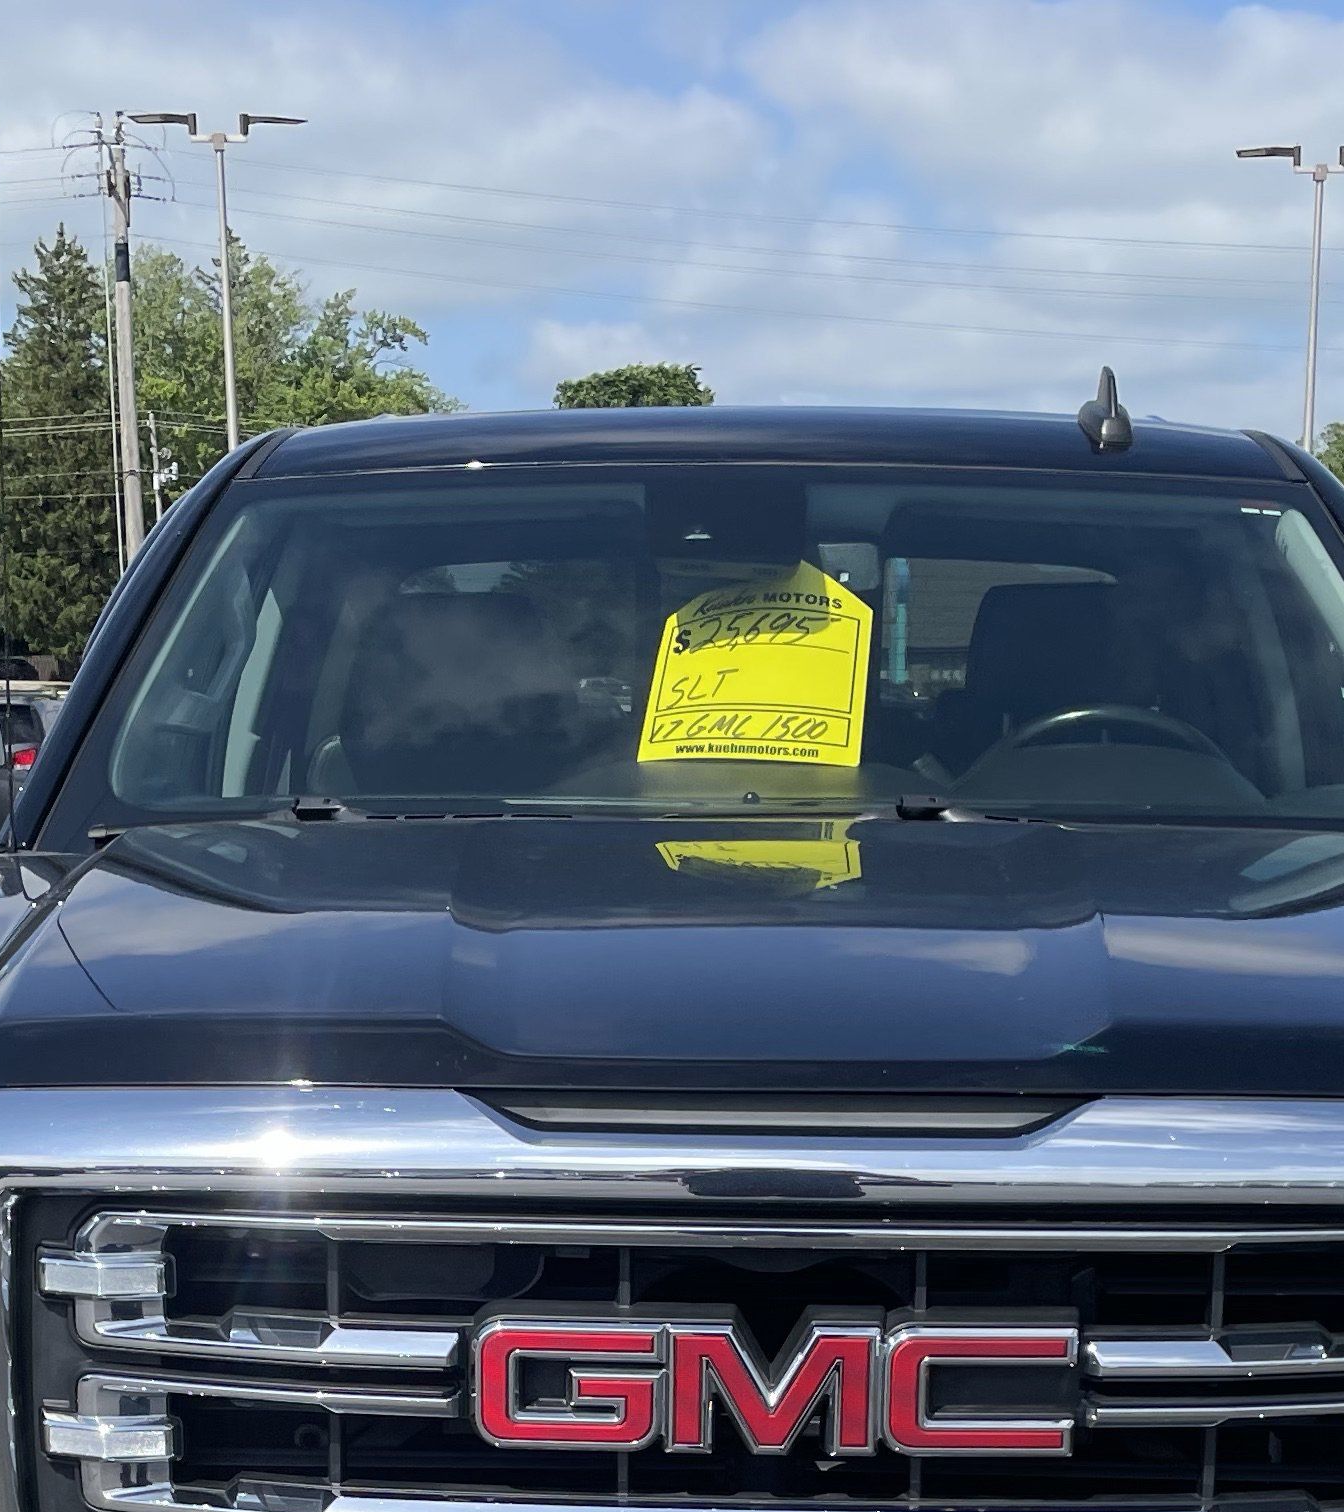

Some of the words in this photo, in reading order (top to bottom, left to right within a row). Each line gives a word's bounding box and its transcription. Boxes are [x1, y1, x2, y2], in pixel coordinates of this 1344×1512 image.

[762, 592, 843, 610] MOTORS
[666, 668, 740, 710] SLT
[686, 713, 753, 739] GMC
[760, 714, 829, 740] 1500
[675, 742, 819, 758] www.kuehnmotors.com
[474, 1318, 1080, 1457] GMC
